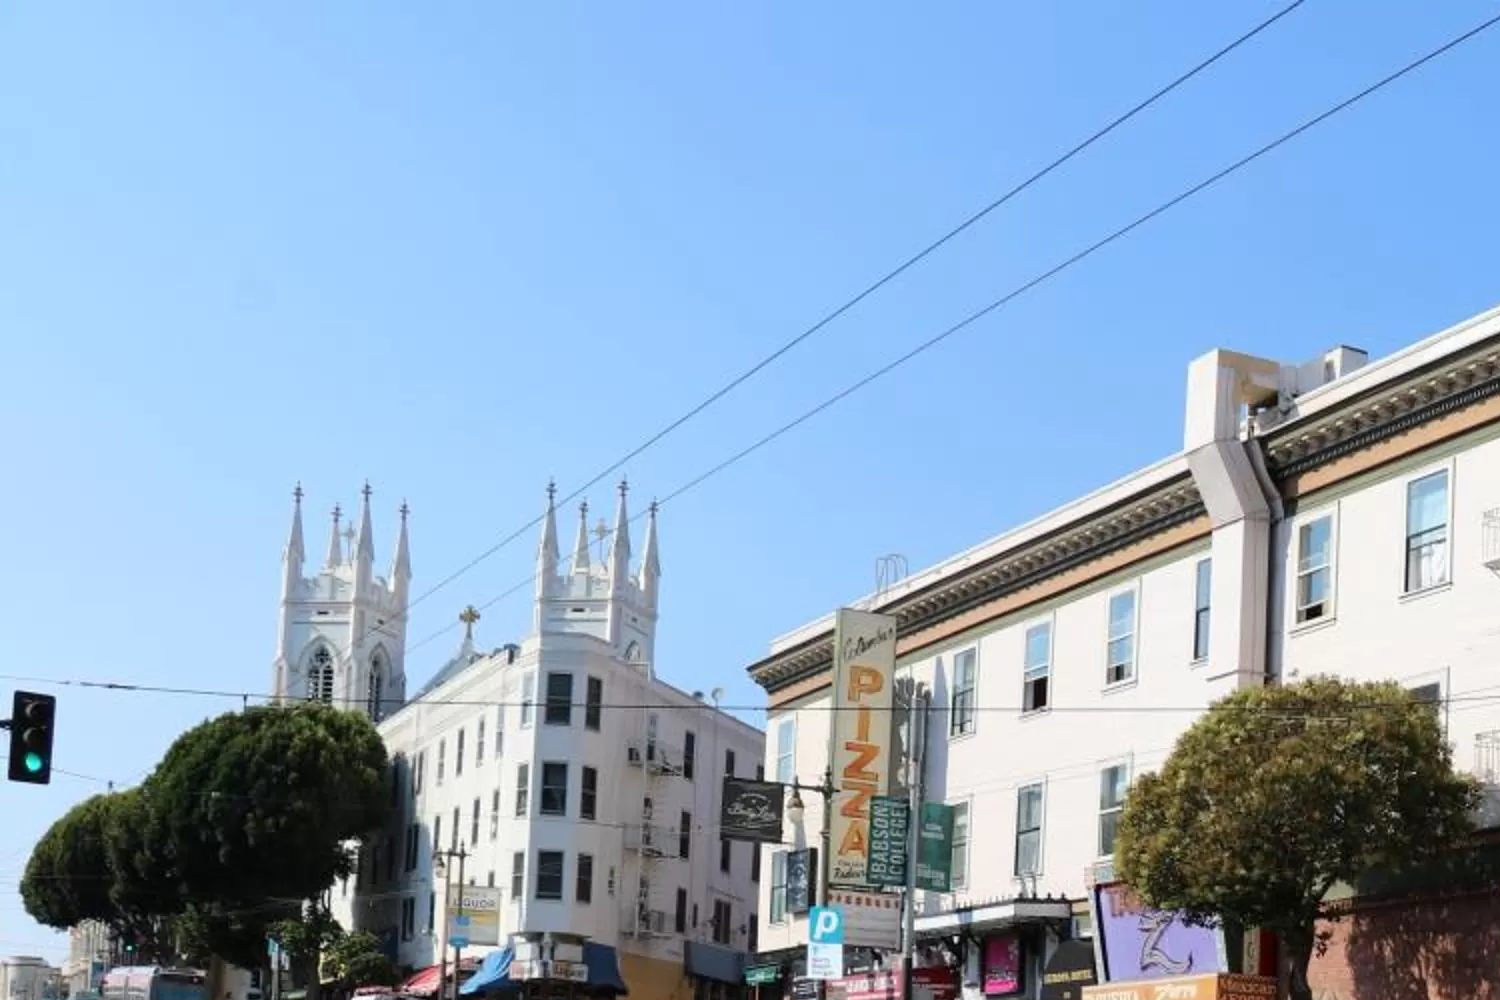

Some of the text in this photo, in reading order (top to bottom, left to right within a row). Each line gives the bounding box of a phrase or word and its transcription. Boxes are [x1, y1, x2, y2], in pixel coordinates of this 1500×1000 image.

[839, 665, 884, 858] PIZZA
[870, 804, 890, 873] BABSON
[888, 807, 907, 875] COLLEGE
